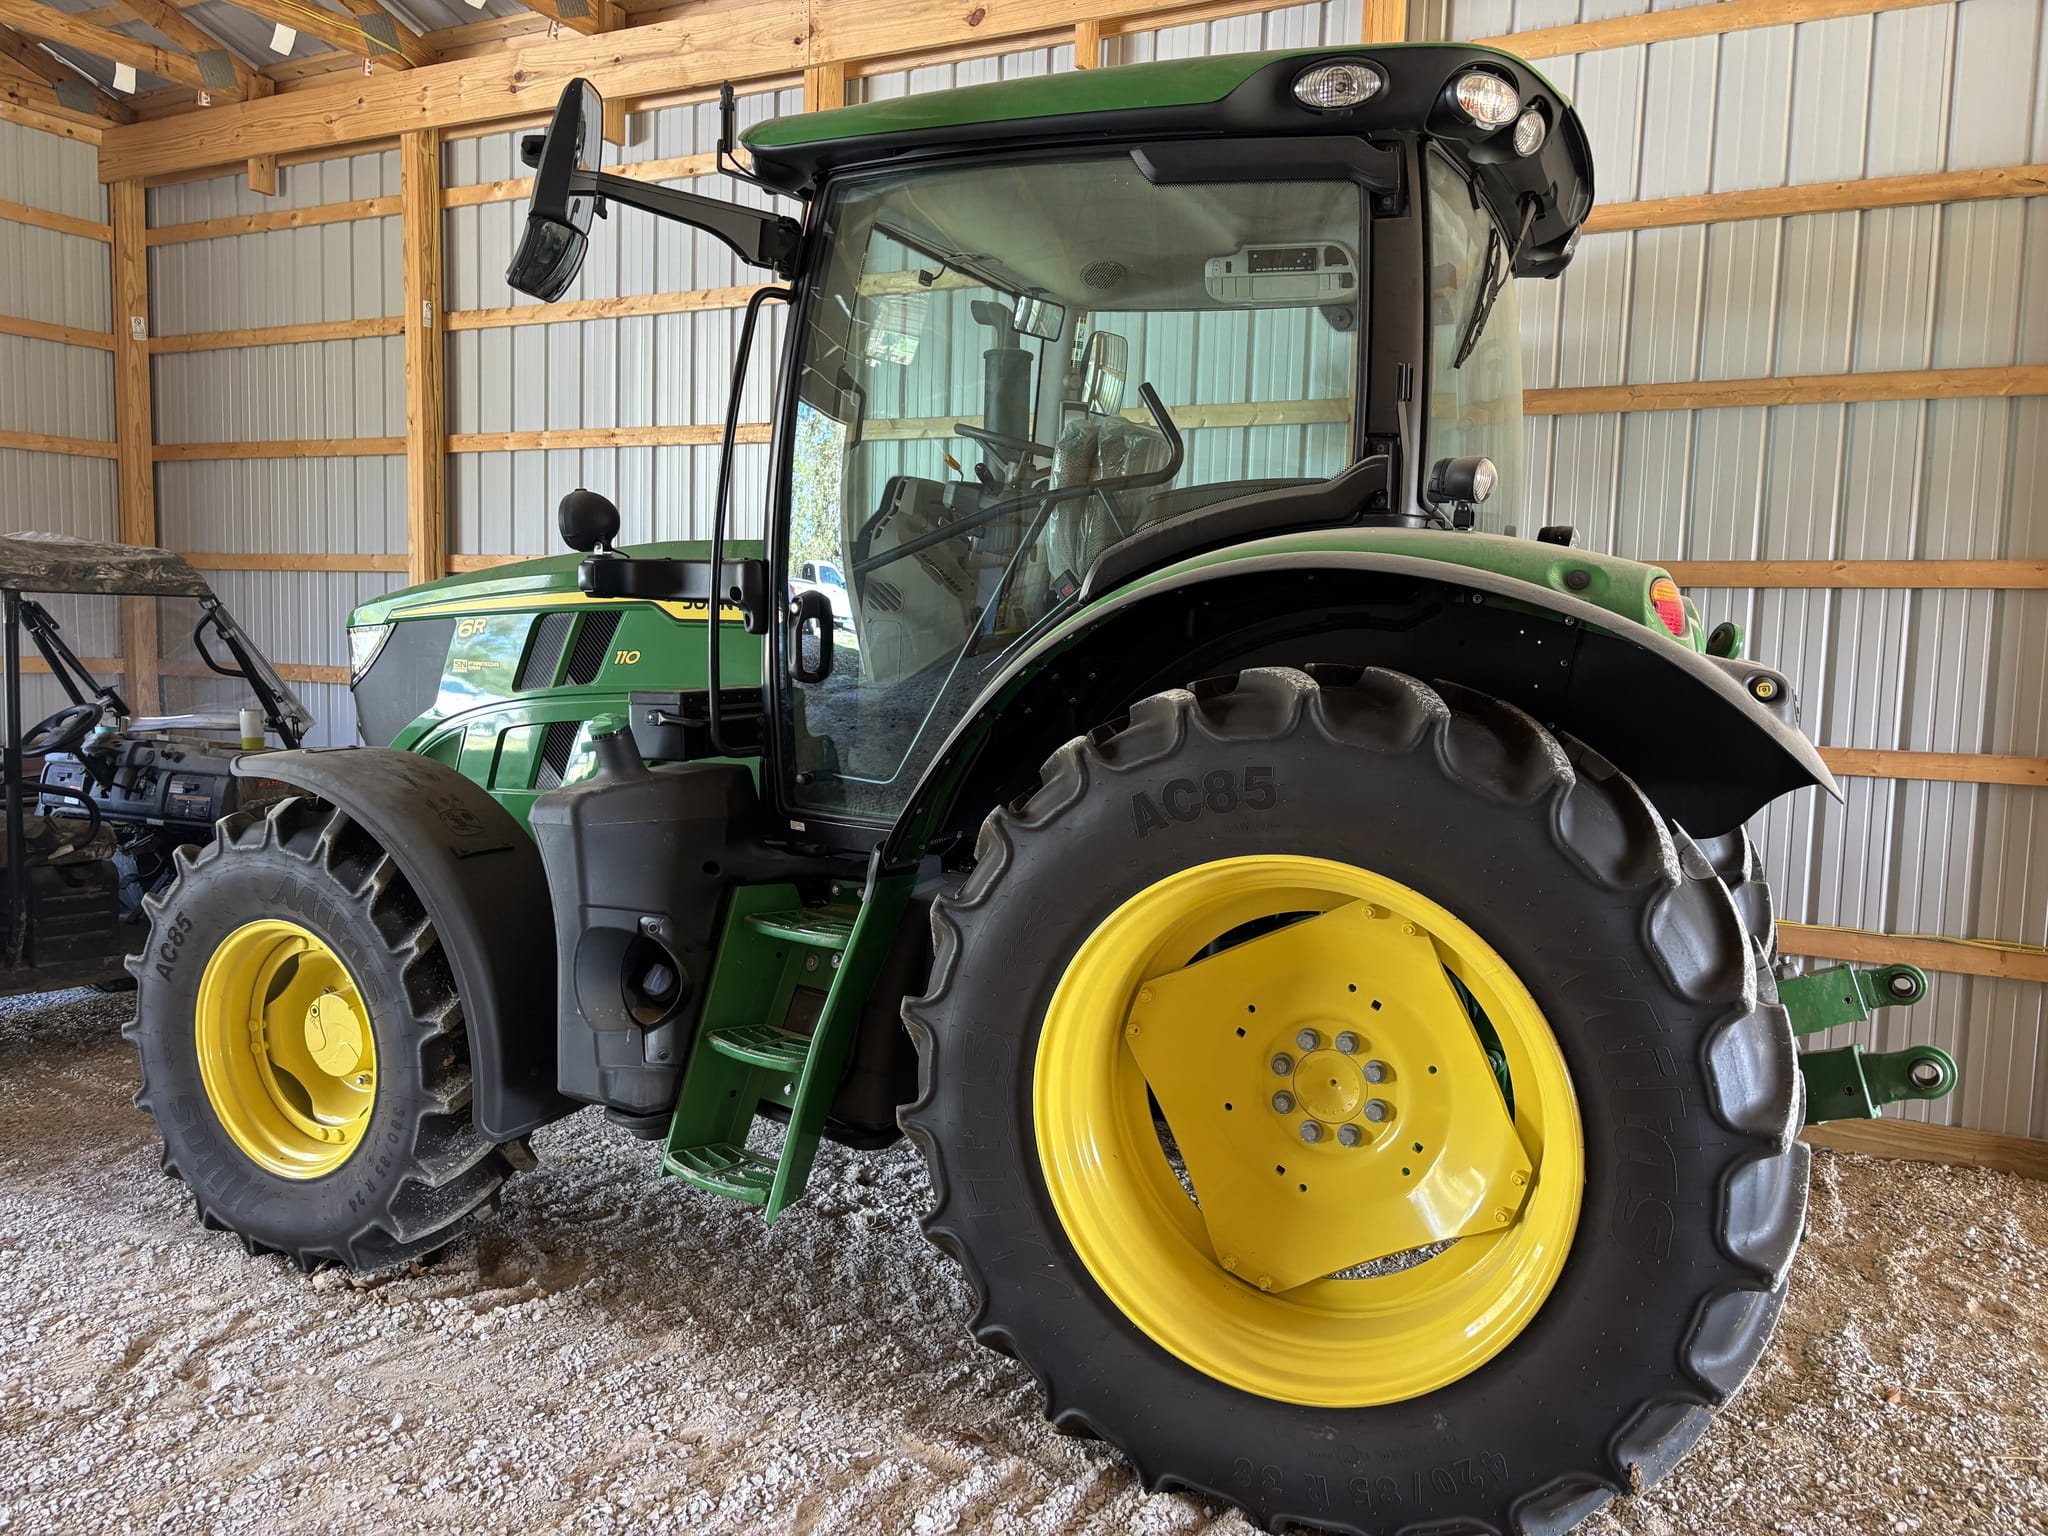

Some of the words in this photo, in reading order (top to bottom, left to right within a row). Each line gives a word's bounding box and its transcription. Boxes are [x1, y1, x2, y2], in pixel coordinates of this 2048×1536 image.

[457, 618, 487, 638] 6R
[614, 650, 641, 665] 110
[1131, 766, 1279, 840] AC85
[156, 911, 193, 983] AC85
[365, 1178, 386, 1194] R
[1303, 1473, 1330, 1507] R
[1349, 1451, 1509, 1509] 420/85
